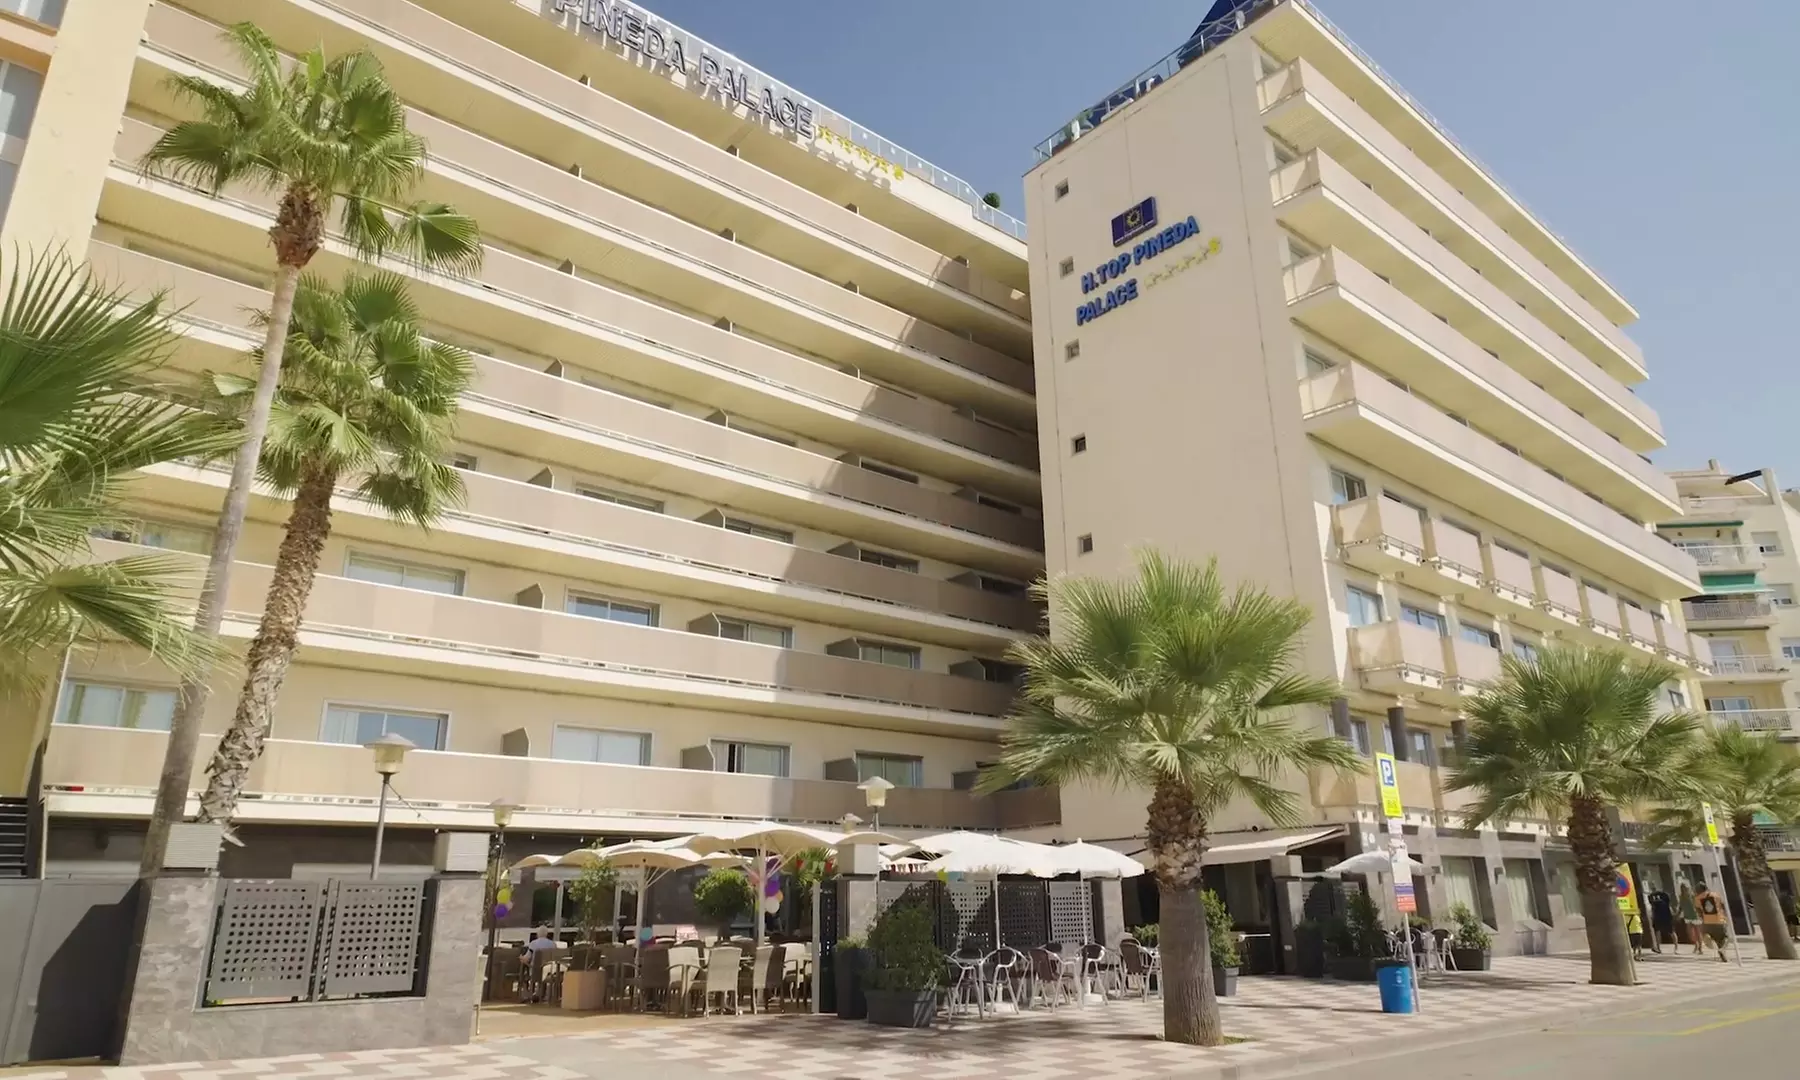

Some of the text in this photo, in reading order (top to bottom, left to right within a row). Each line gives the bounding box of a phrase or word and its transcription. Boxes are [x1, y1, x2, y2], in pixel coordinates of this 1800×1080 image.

[700, 53, 816, 140] PALACE
[1081, 252, 1132, 294] H.TOP
[1133, 215, 1200, 266] PINEDA
[1076, 278, 1139, 326] PALACE
[1381, 760, 1392, 784] P
